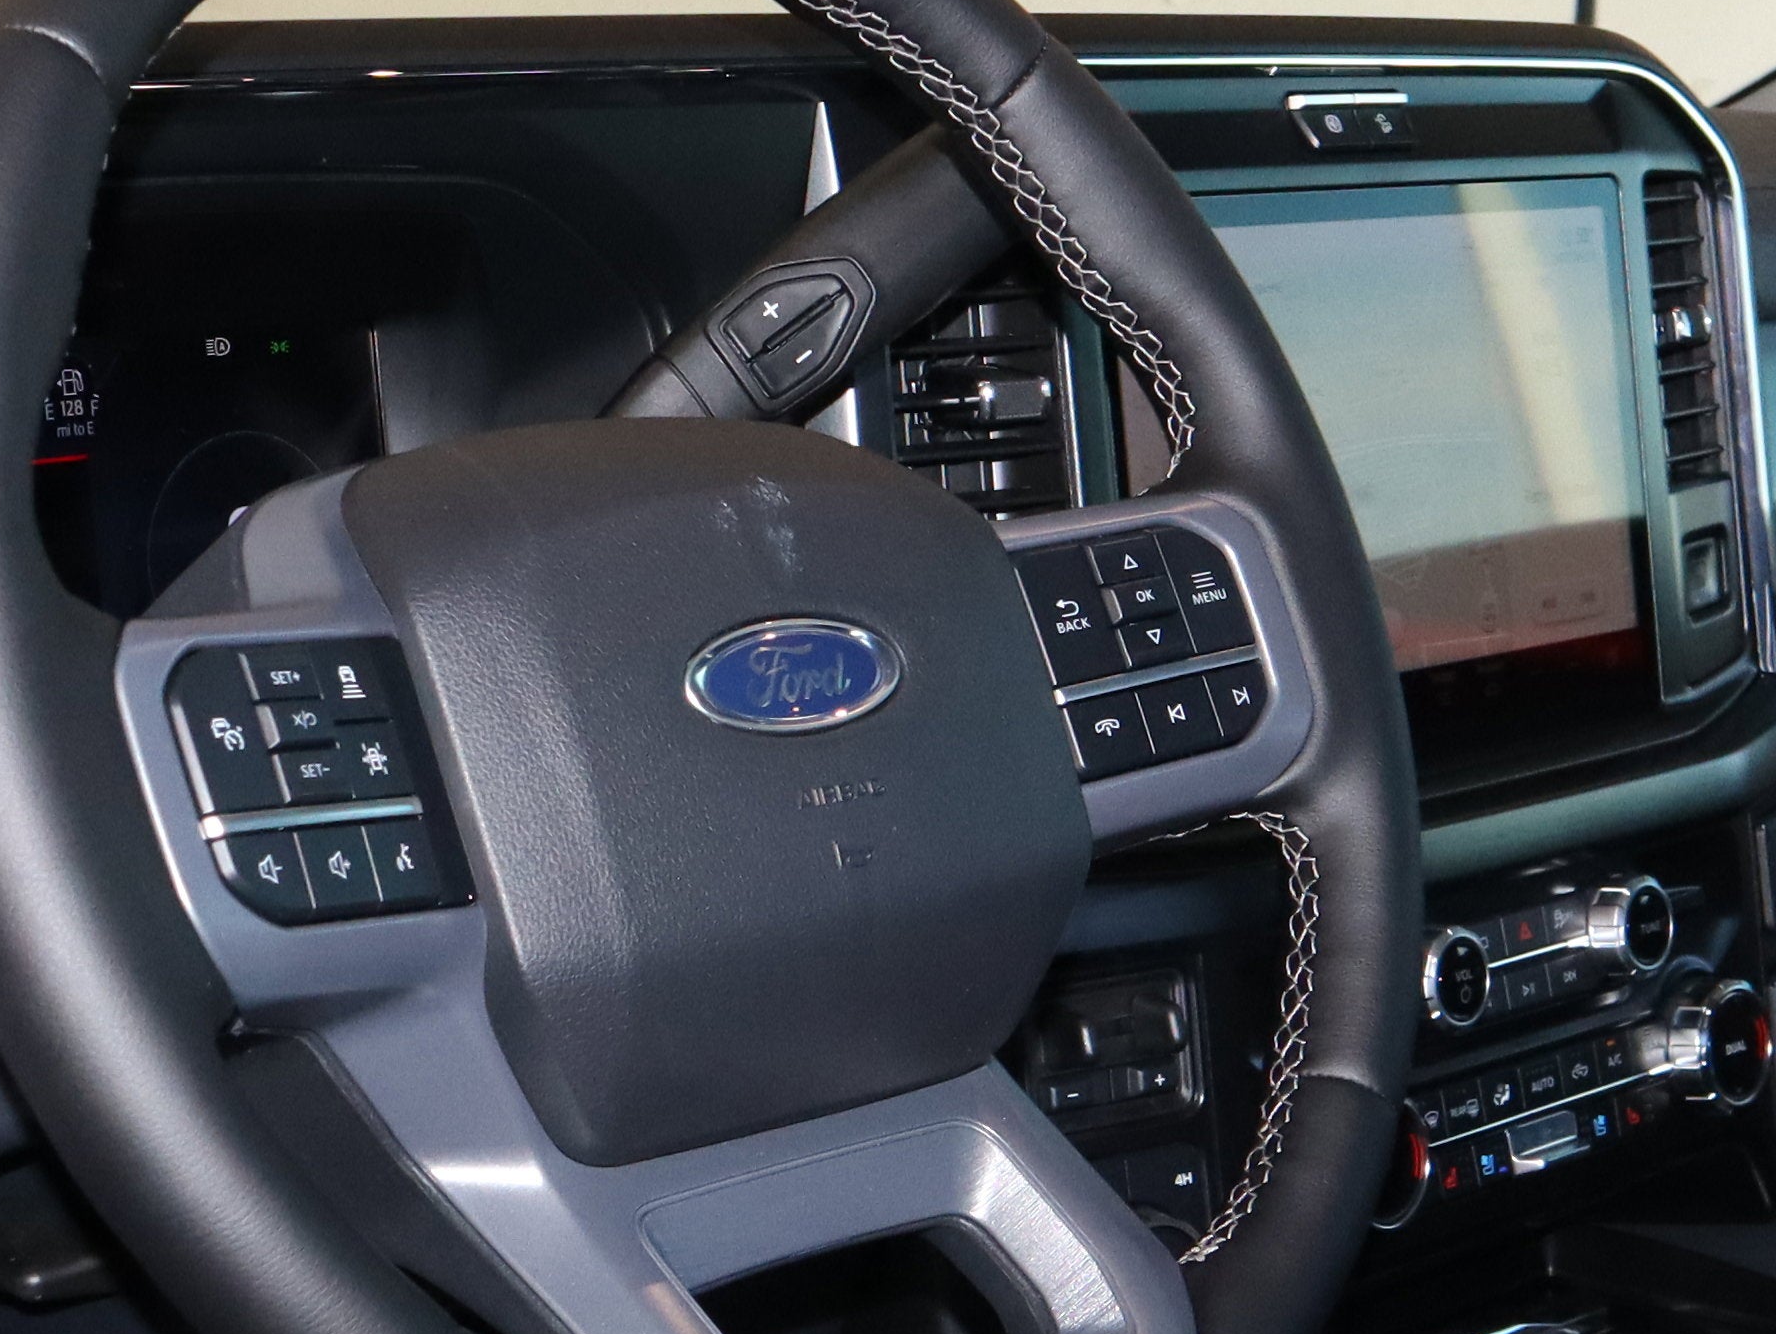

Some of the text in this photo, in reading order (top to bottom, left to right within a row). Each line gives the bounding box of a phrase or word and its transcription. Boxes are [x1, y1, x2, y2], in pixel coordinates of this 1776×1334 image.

[59, 399, 85, 418] 128
[1136, 589, 1155, 603] OK
[1192, 588, 1227, 605] MENU
[1056, 617, 1091, 634] BACK
[747, 644, 852, 708] Ford
[1531, 1076, 1554, 1092] AUTO
[1174, 1171, 1193, 1187] 4H
